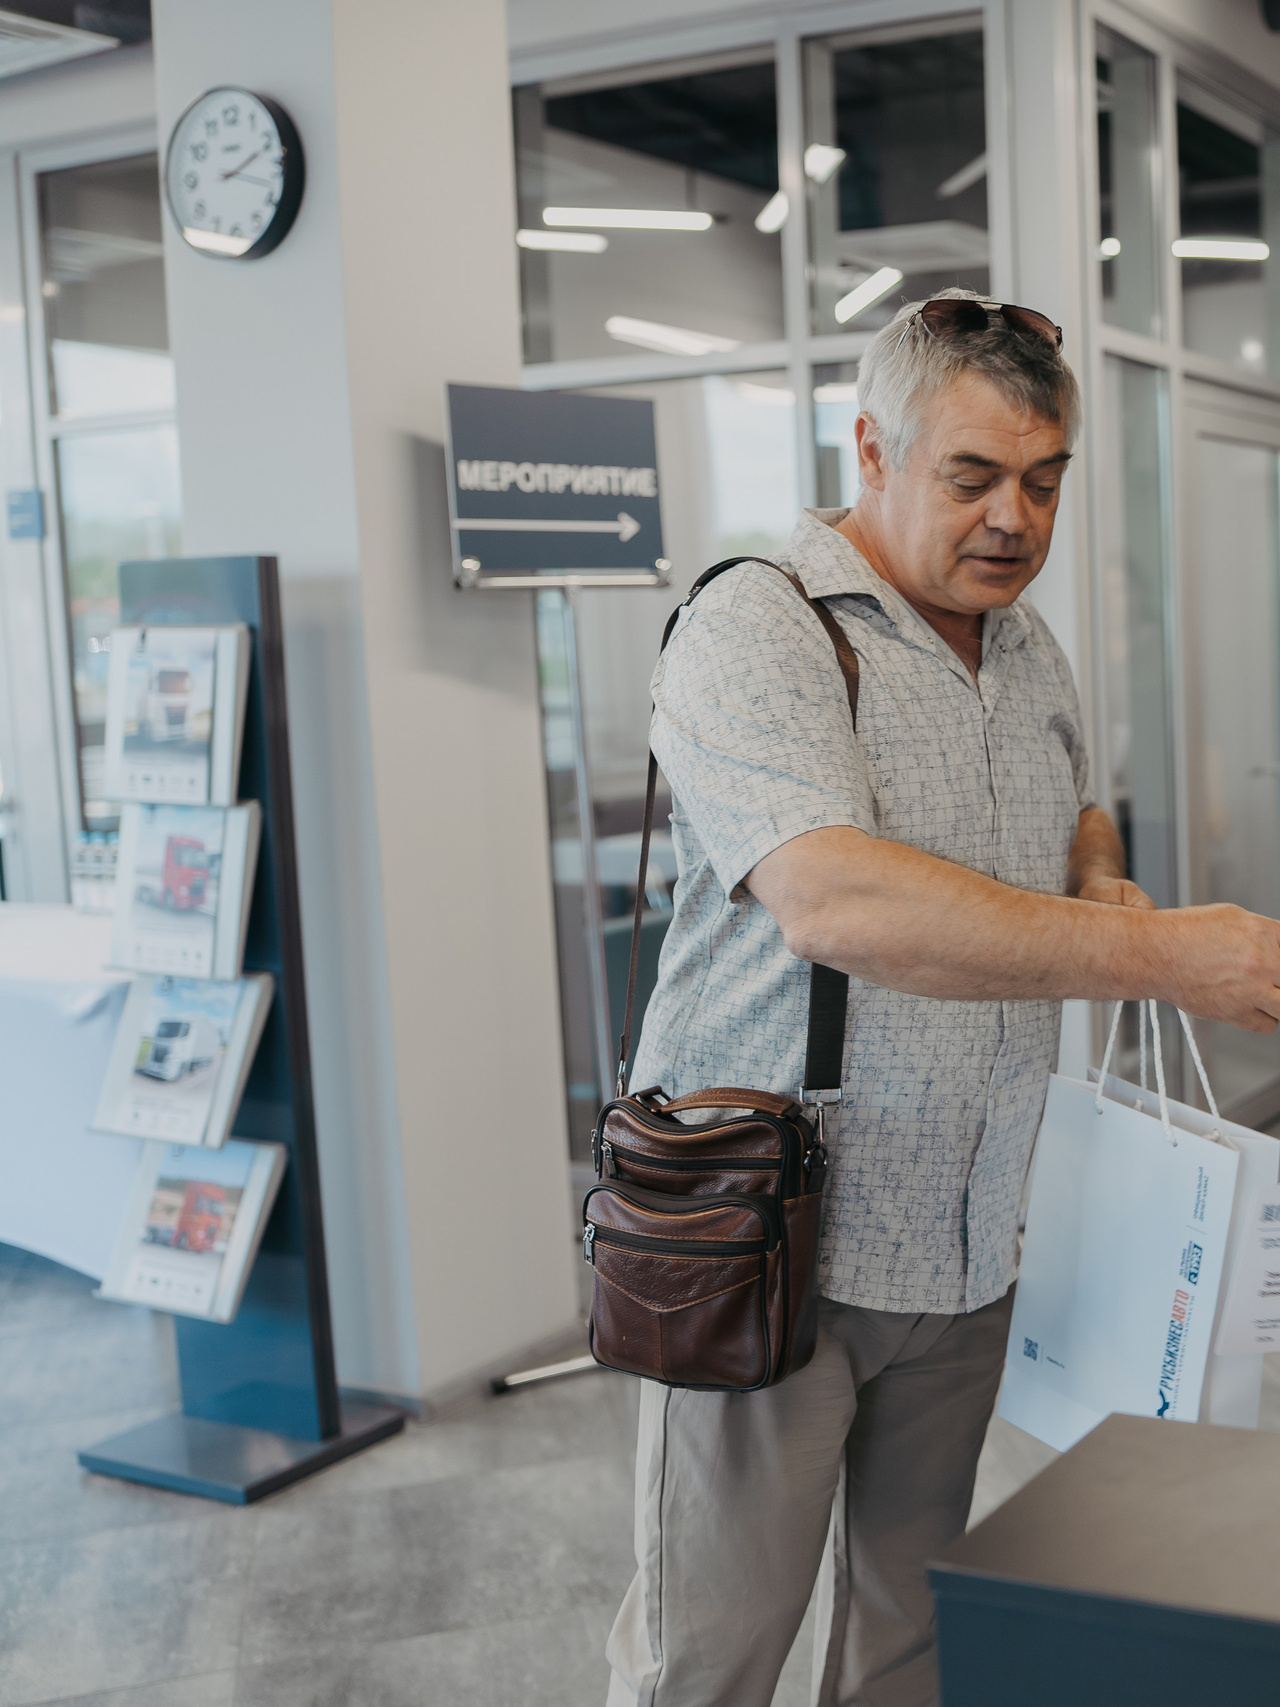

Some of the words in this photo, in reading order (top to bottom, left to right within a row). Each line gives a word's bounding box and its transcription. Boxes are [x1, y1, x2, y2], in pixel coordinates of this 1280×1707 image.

[222, 105, 238, 126] 12
[262, 131, 273, 150] 2
[191, 141, 207, 161] 10
[184, 170, 198, 190] 9
[457, 459, 658, 497] МЕРОПРИЯТИЕ
[1160, 1289, 1189, 1391] РУСБИЗНЕСАВТО
